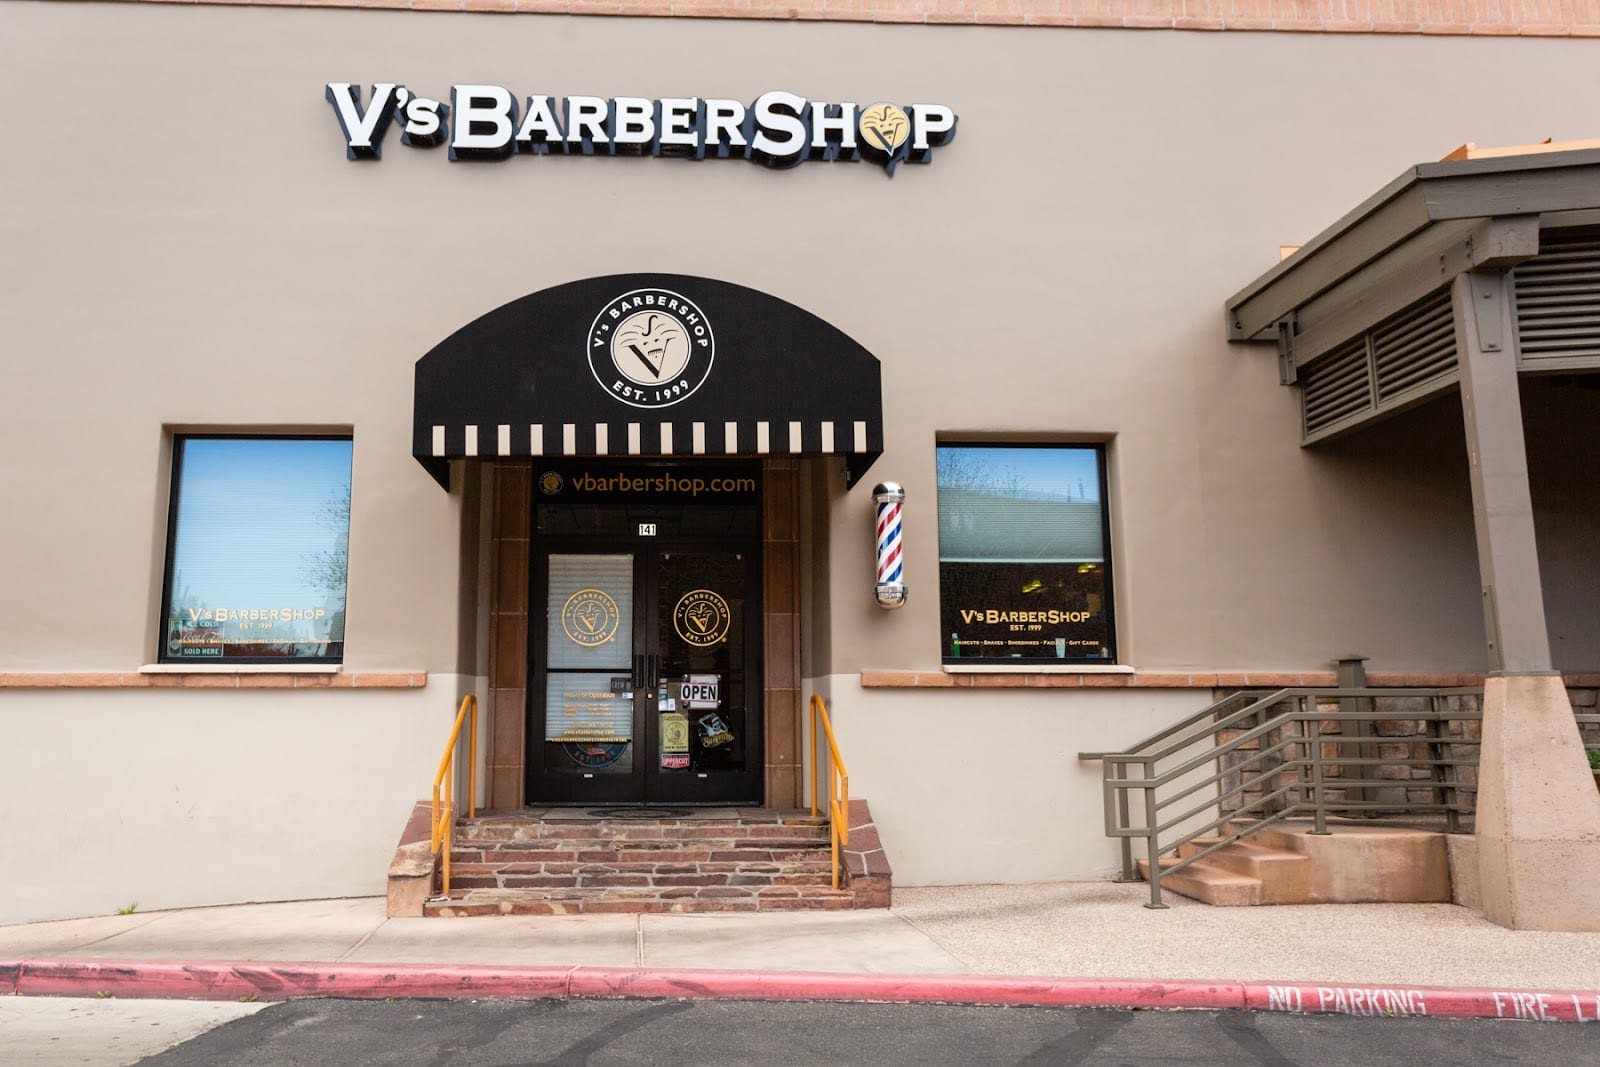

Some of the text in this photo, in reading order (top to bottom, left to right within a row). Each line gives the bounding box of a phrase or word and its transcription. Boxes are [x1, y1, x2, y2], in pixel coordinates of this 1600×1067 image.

[609, 294, 709, 348] BARBERSHOP
[612, 379, 690, 401] EST. 1999
[571, 472, 757, 497] vbarbershop.com
[639, 523, 656, 536] 141
[684, 591, 727, 619] BARBERSHOP
[1009, 624, 1042, 632] EST. 1999
[183, 648, 220, 656] SOLD HERE
[682, 685, 717, 700] OPEN
[1267, 985, 1302, 1012] NO
[1318, 987, 1427, 1017] PARKING
[1492, 991, 1558, 1022] FIRE
